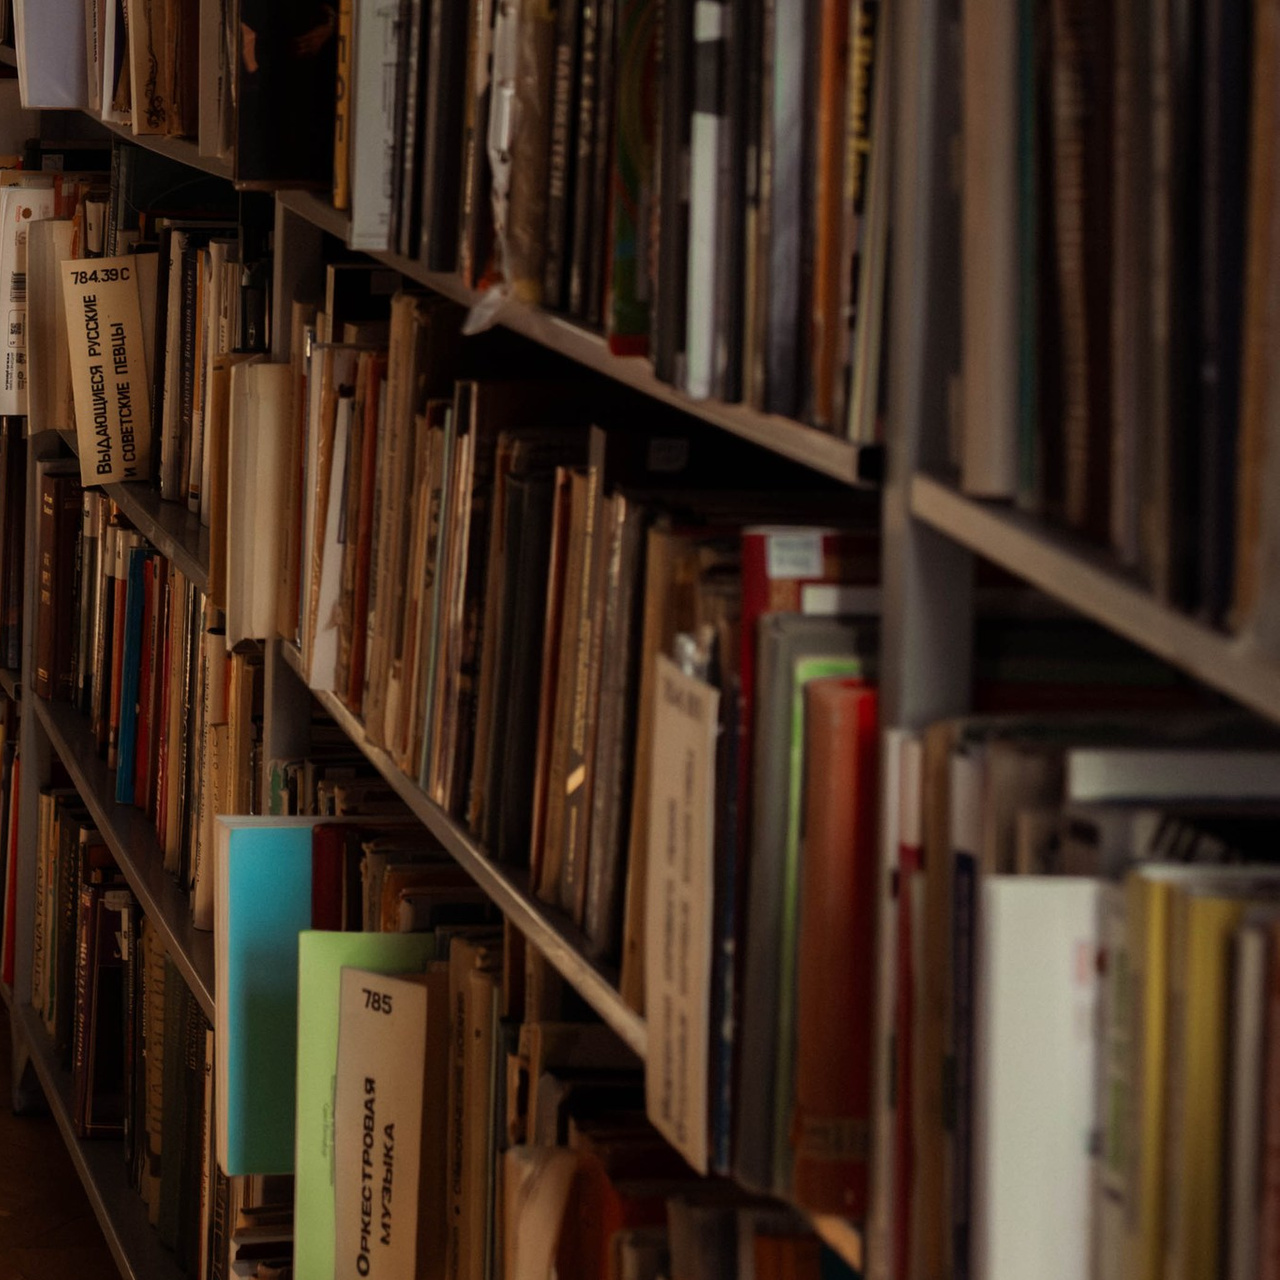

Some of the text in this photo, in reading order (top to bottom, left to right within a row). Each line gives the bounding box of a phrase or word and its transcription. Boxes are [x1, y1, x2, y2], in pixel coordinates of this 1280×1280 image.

[82, 293, 102, 357] РУССКИЕ
[110, 322, 137, 478] И СОВЕТСКИЕ ПЕВЦЫ
[361, 988, 394, 1015] 785
[379, 1122, 396, 1246] МУЗЫКА
